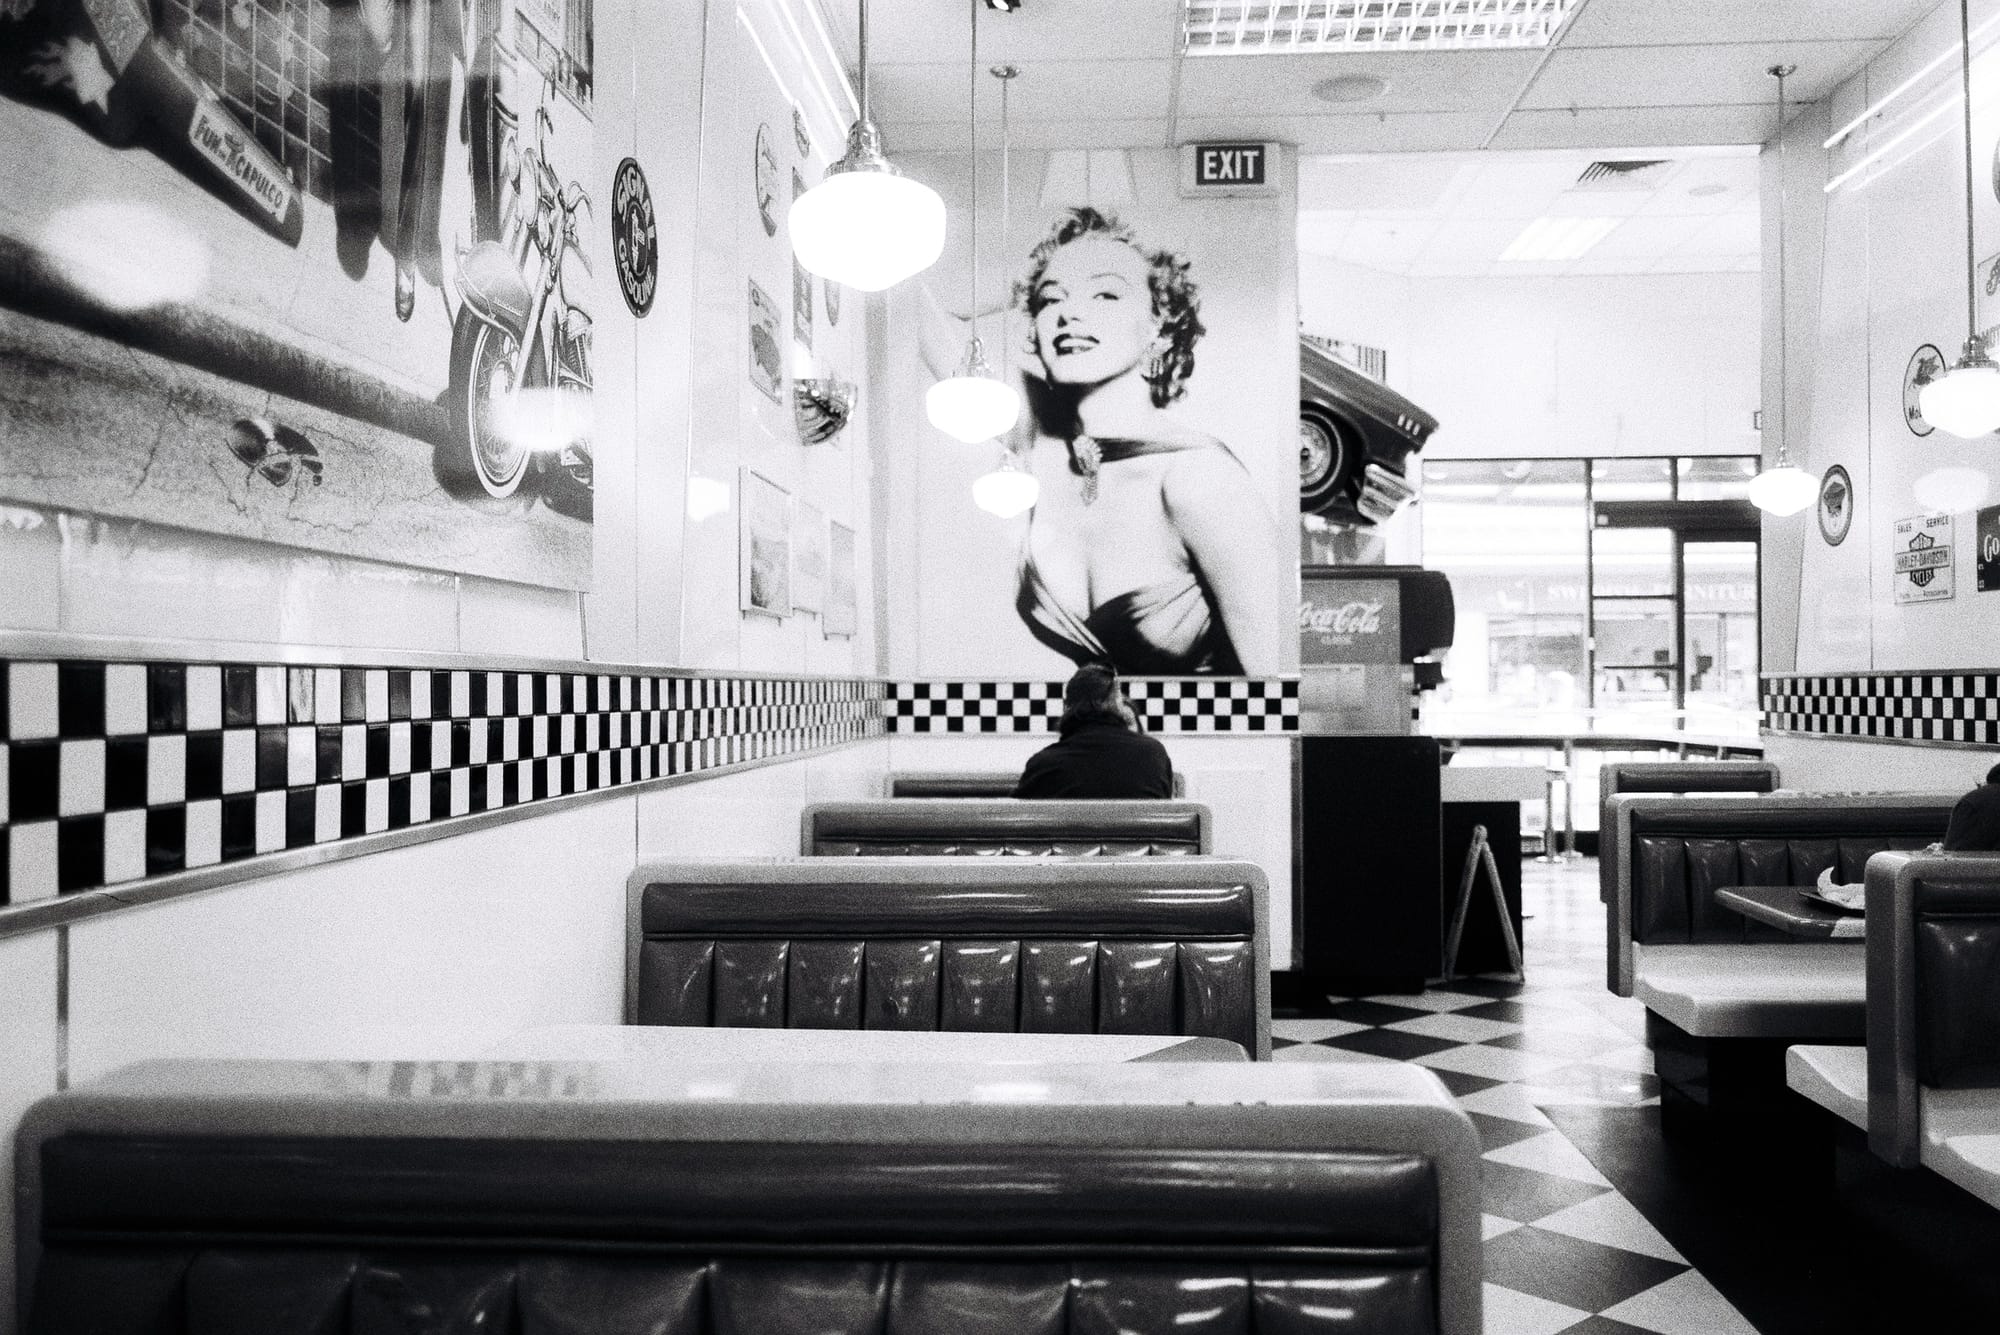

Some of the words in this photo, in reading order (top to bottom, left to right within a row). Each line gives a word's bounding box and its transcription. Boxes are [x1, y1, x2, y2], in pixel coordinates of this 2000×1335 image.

[1203, 150, 1259, 180] EXIT
[617, 167, 655, 249] SIGNAL
[619, 238, 654, 305] GASOLINE
[1897, 523, 1911, 533] SALES
[1926, 515, 1949, 528] SERVICE
[1898, 550, 1948, 567] HARLEY-DAVIDSON
[1911, 570, 1933, 585] CYCLES
